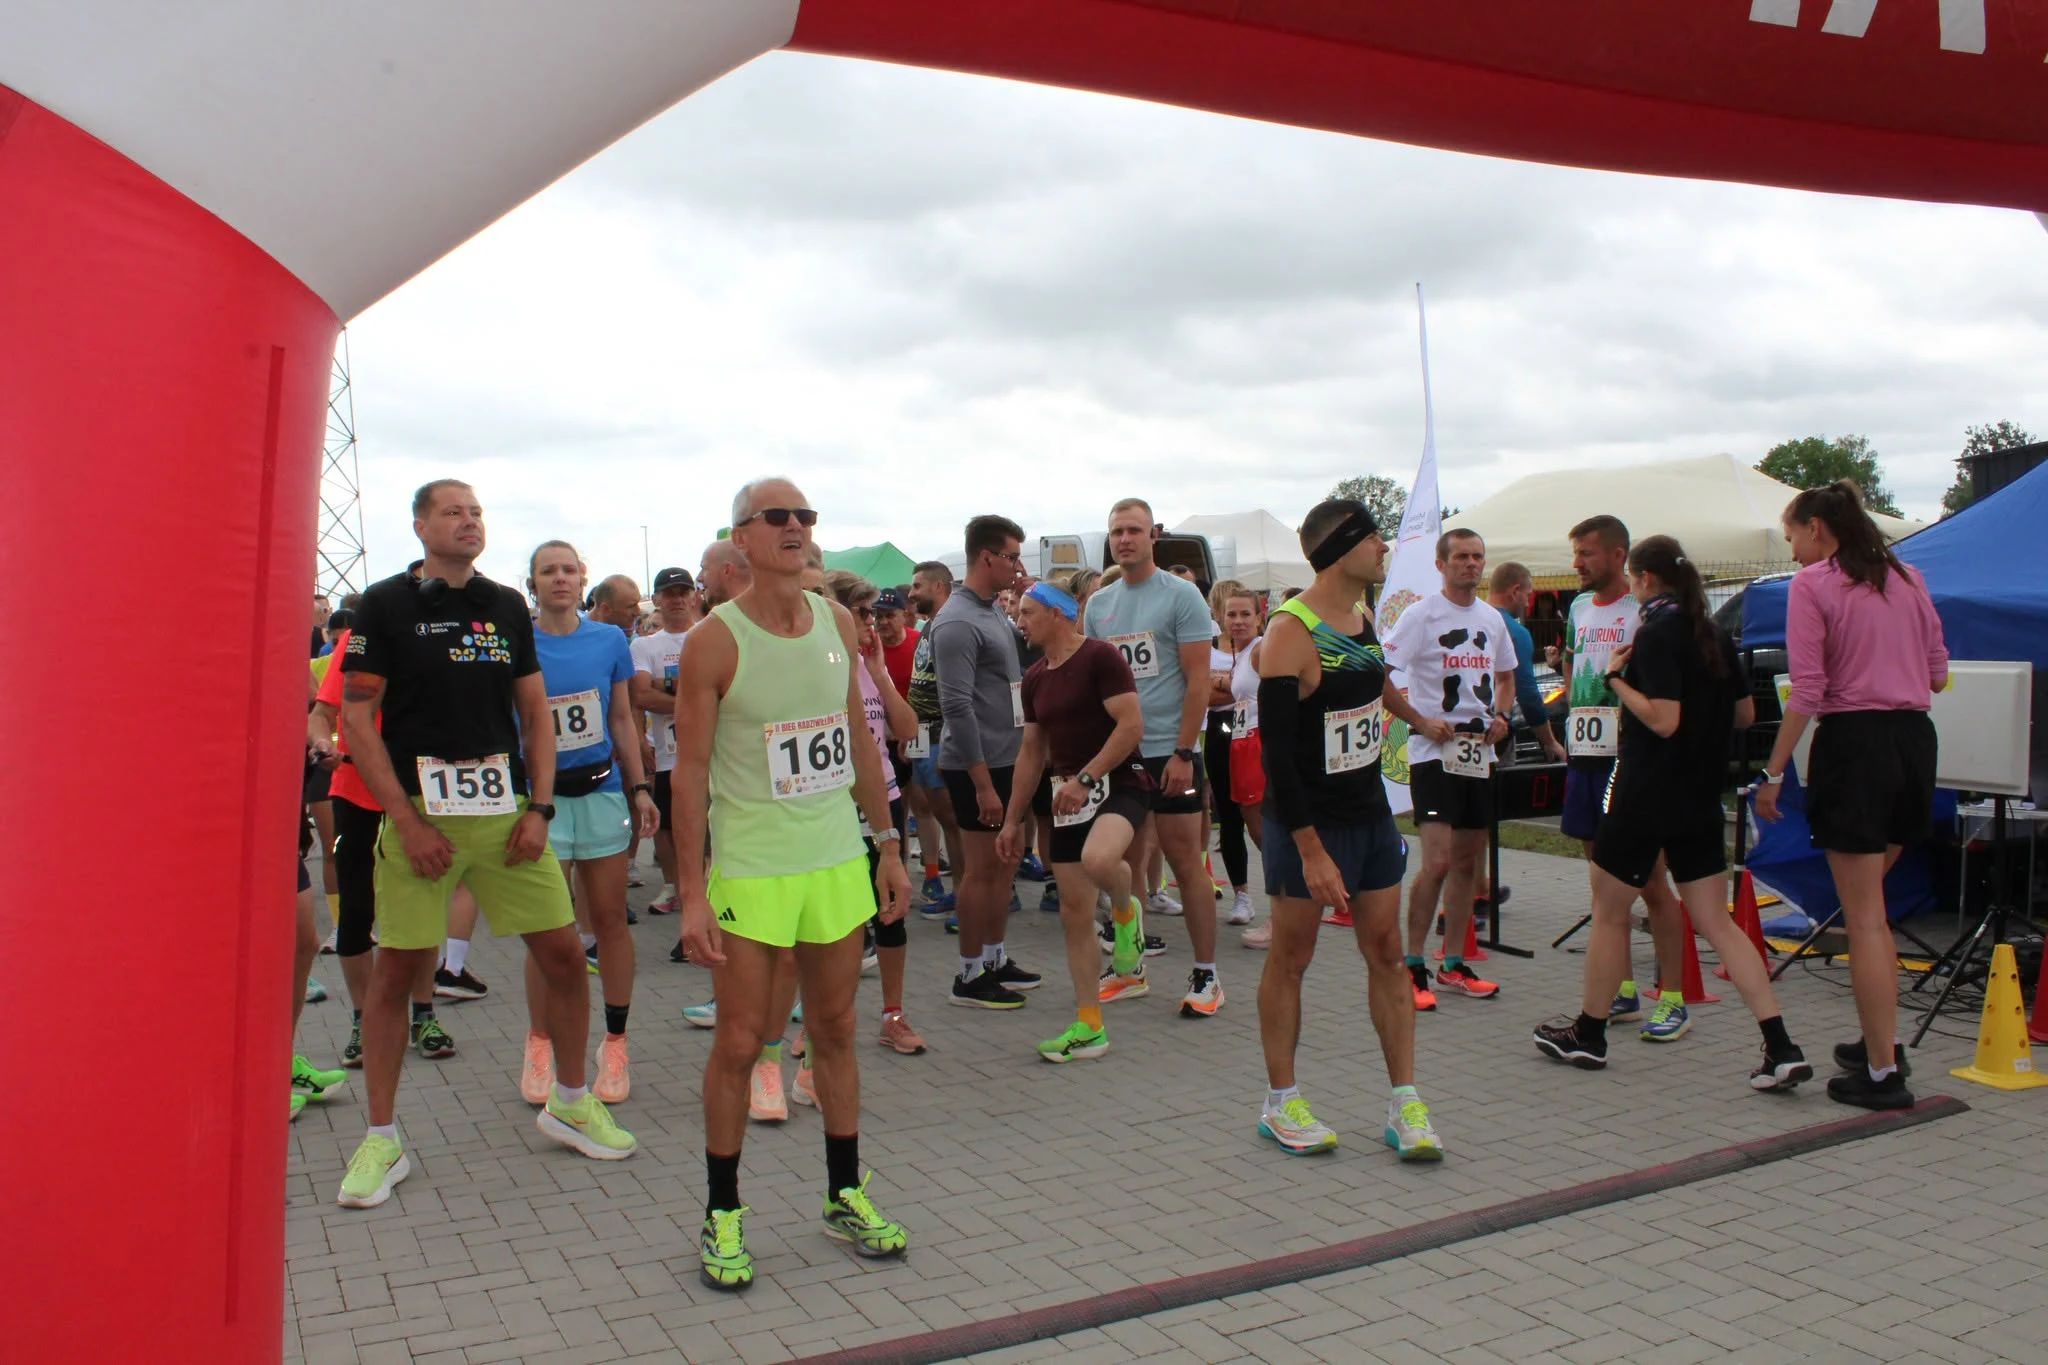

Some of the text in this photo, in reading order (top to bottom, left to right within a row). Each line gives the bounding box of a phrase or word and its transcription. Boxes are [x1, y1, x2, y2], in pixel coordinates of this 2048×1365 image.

[781, 721, 796, 732] BIEG
[1335, 711, 1380, 753] 136
[1575, 716, 1603, 742] 80
[780, 727, 846, 775] 168
[1457, 740, 1482, 765] 35
[430, 767, 505, 800] 158
